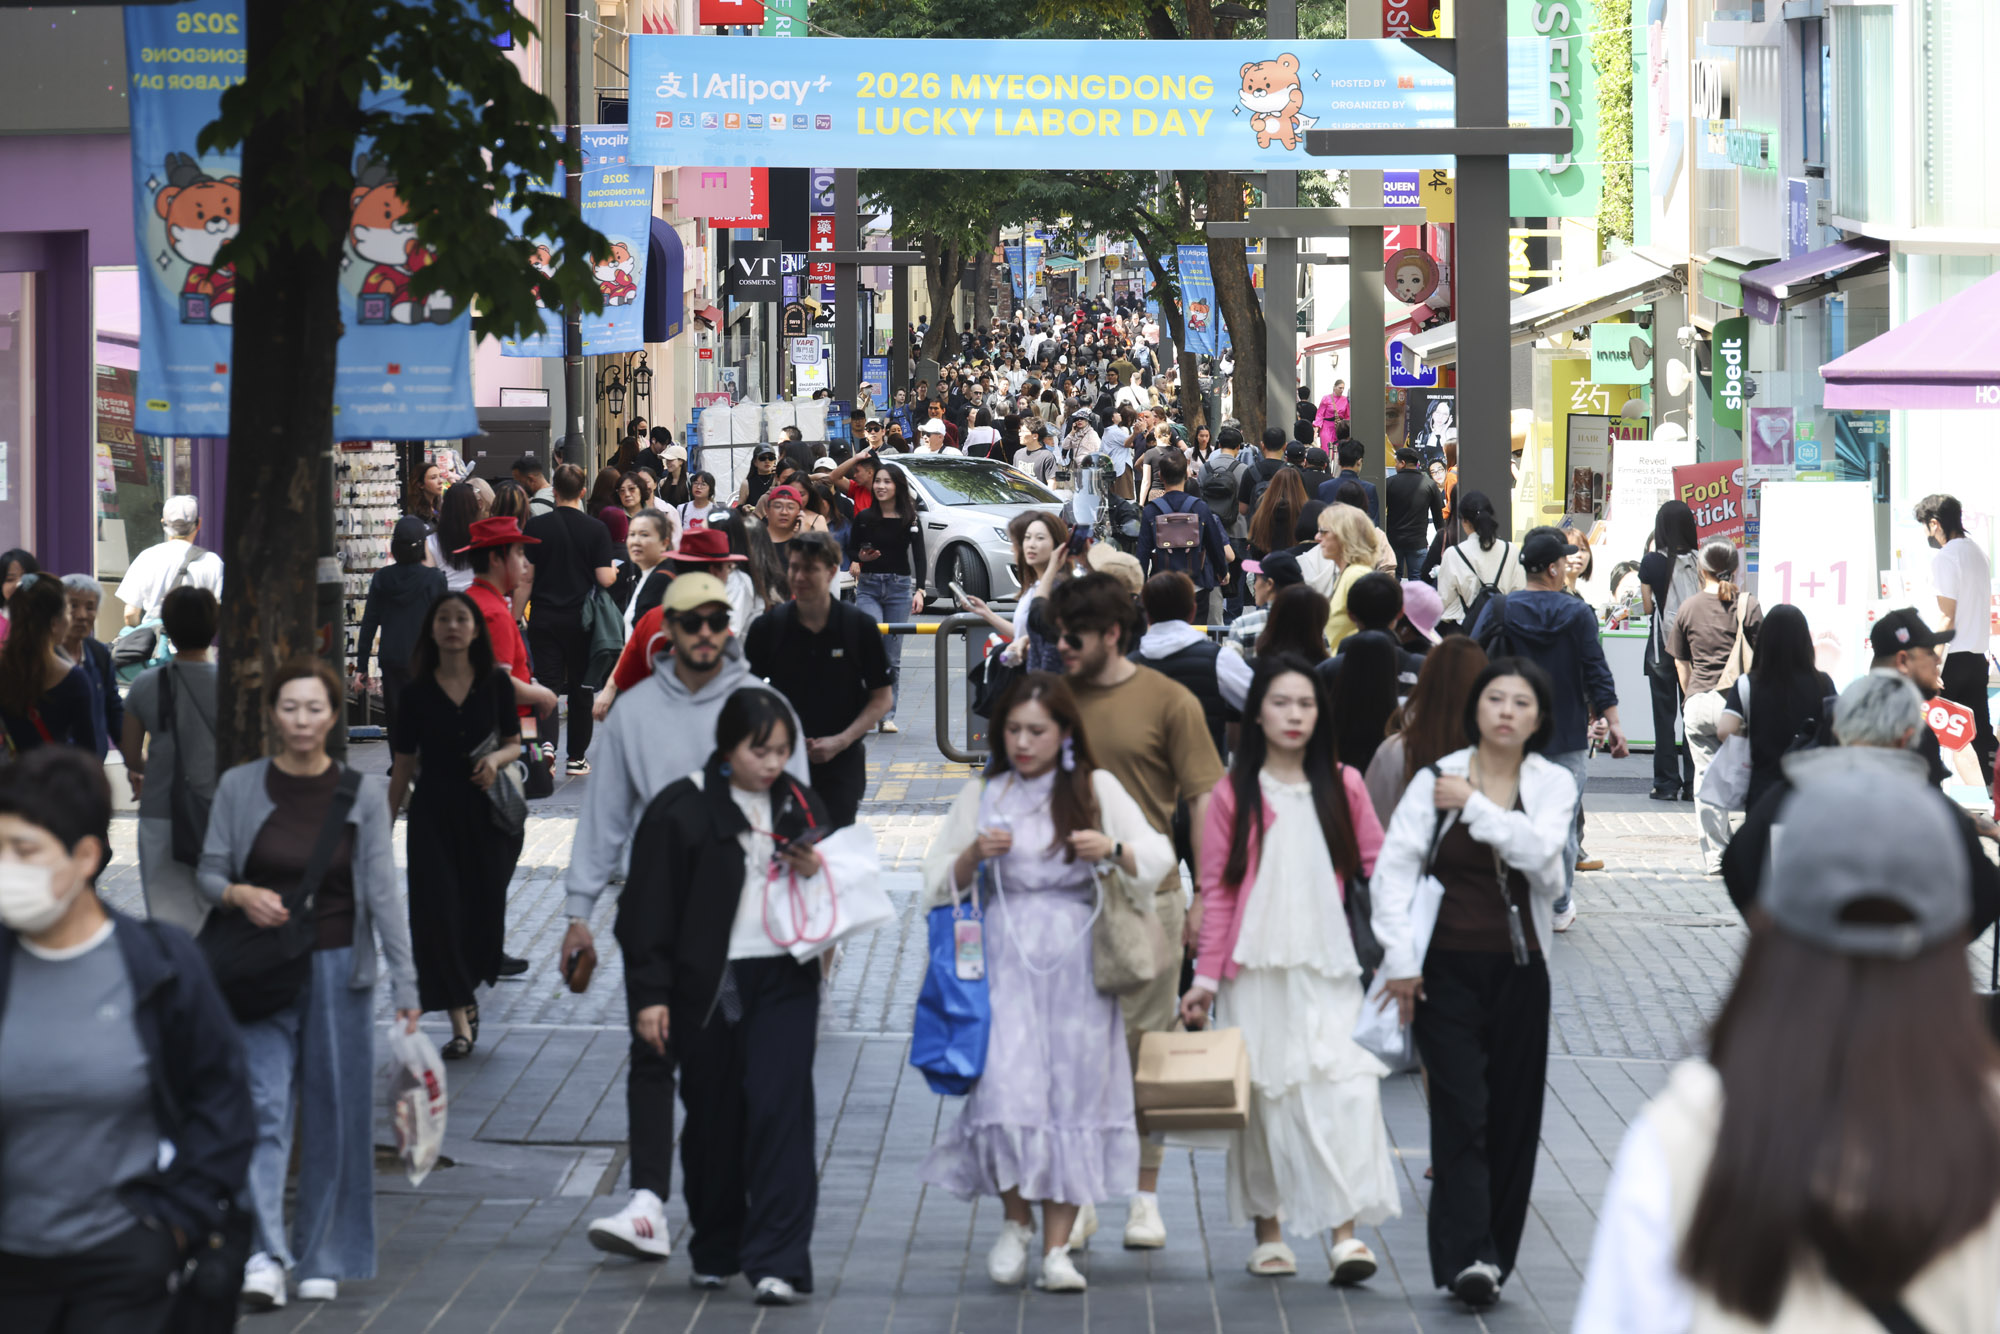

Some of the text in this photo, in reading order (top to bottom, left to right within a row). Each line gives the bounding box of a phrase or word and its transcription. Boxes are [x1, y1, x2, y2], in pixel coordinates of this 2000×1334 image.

[703, 73, 832, 106] Alipay+
[856, 72, 1215, 100] 2026 MYEONGDONG
[1331, 79, 1387, 88] HOSTED BY
[1331, 101, 1391, 110] ORGANIZED
[1392, 101, 1406, 109] BY
[816, 119, 830, 129] Pay
[857, 107, 1214, 136] LUCKY LABOR DAY
[1383, 182, 1416, 191] QUEEN
[1391, 366, 1434, 376] HOAY
[1570, 377, 1610, 415] 药
[1874, 420, 1886, 434] 3
[1577, 433, 1599, 443] HAIR
[1639, 456, 1668, 466] Reveal
[1618, 466, 1649, 475] Firmness
[1642, 476, 1653, 485] 28
[1653, 477, 1672, 486] Days
[1680, 475, 1730, 504] Foot
[1690, 498, 1738, 528] tick
[1774, 560, 1848, 606] 1+1
[1927, 706, 1969, 738] 50
